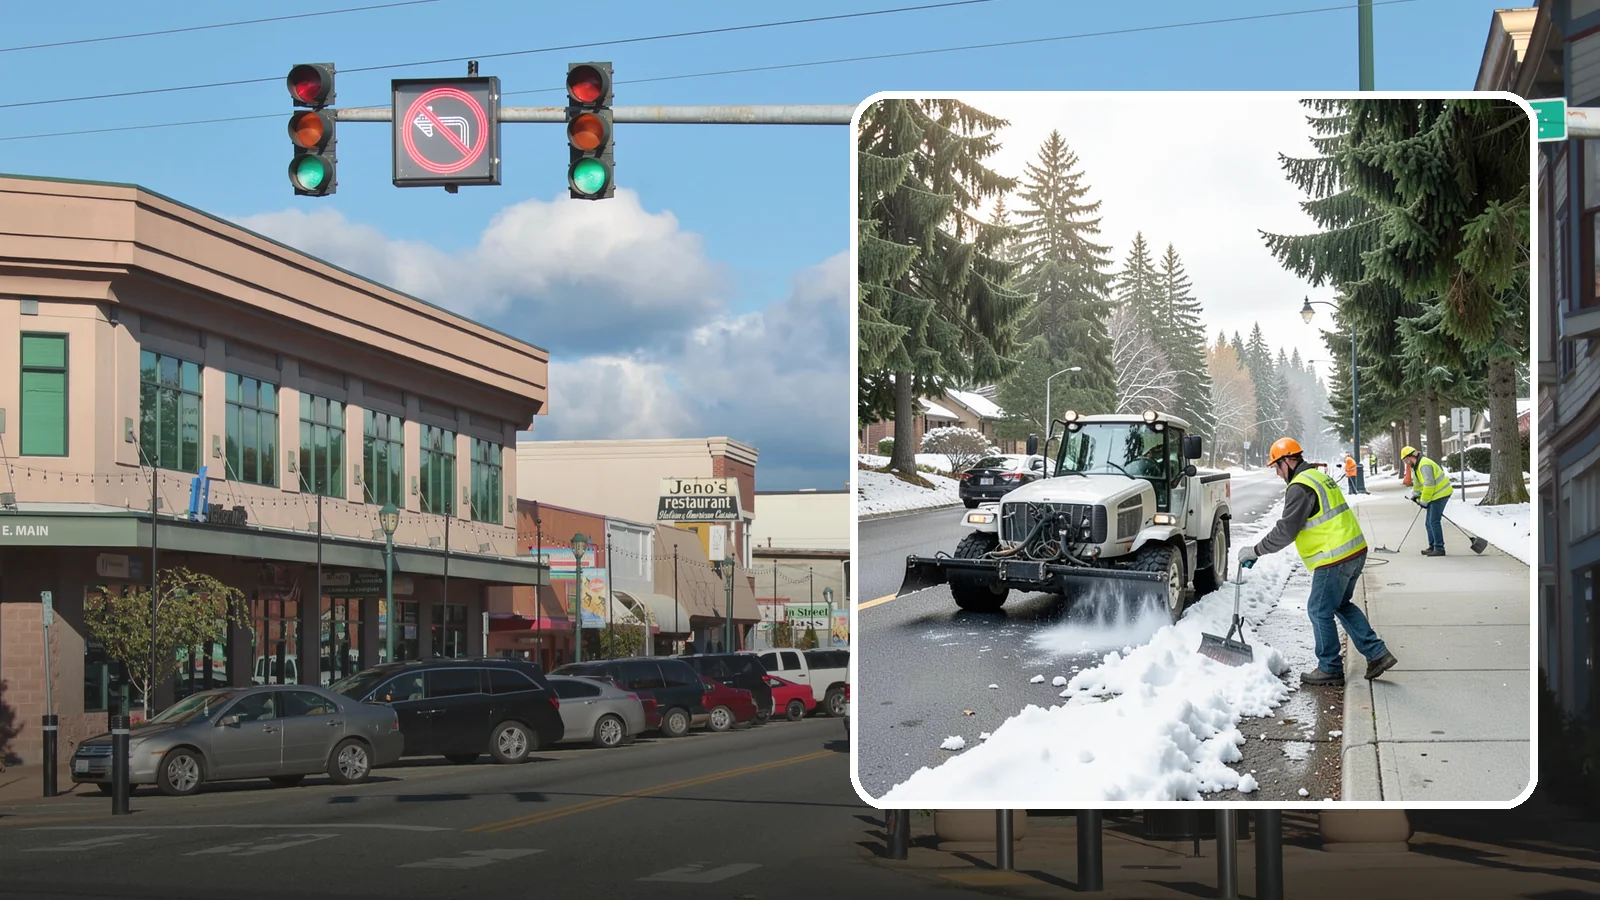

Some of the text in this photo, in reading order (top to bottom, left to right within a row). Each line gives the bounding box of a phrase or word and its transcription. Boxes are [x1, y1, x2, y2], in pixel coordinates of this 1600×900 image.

[670, 480, 727, 494] Jeno's
[665, 496, 731, 509] restaurant
[659, 510, 682, 519] Italian
[686, 510, 715, 519] American
[715, 510, 737, 519] Cuisine
[2, 525, 49, 536] E. MAIN
[797, 608, 829, 617] Street
